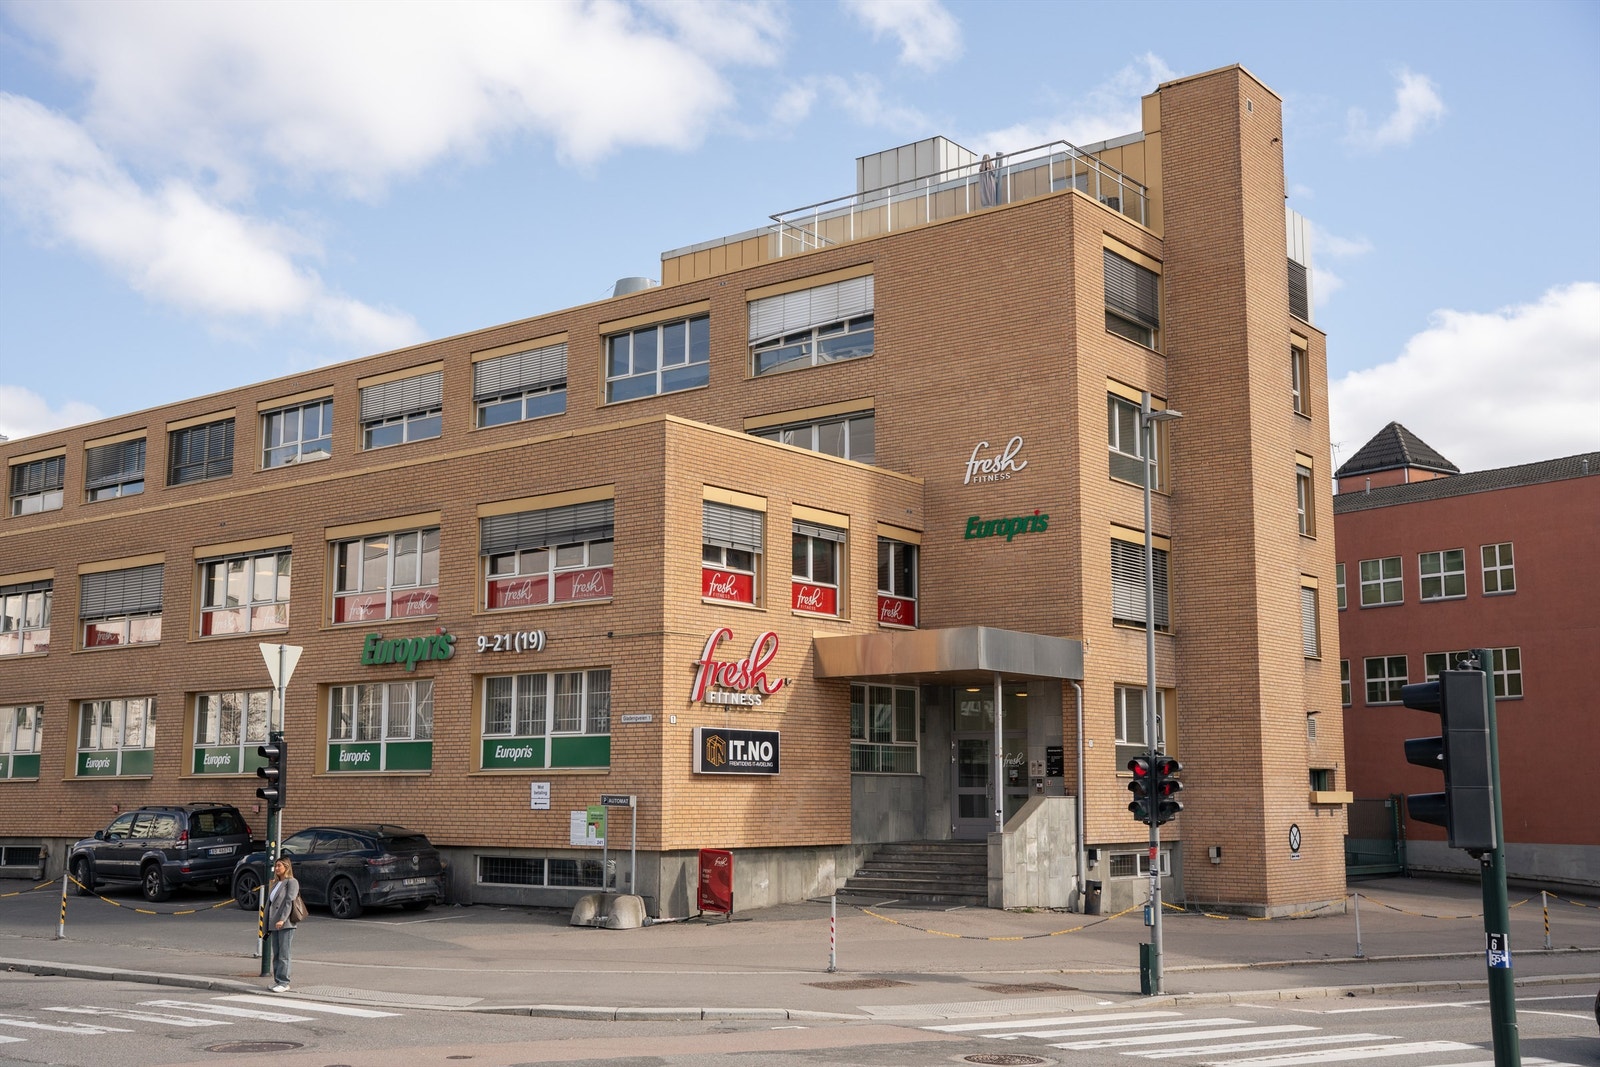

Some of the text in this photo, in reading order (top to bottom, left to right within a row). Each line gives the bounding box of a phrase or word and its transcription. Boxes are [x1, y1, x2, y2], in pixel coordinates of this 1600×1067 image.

[963, 435, 1028, 485] fresh
[973, 472, 1011, 483] FITNESS
[964, 509, 1050, 542] Europris
[504, 579, 533, 606] fresh
[571, 569, 603, 598] fresh
[709, 572, 737, 596] fresh
[406, 590, 432, 615] fresh
[797, 586, 823, 608] fresh
[881, 599, 903, 620] fresh
[361, 627, 457, 672] Europris
[477, 630, 547, 654] 9-21 (19)
[692, 627, 785, 702] fresh
[706, 691, 762, 706] FITNESS
[203, 753, 231, 767] Europris
[339, 750, 371, 765] Europris
[495, 745, 533, 761] Europris
[728, 740, 773, 761] IT.NO
[1003, 752, 1025, 767] fresh
[86, 757, 110, 770] Europris
